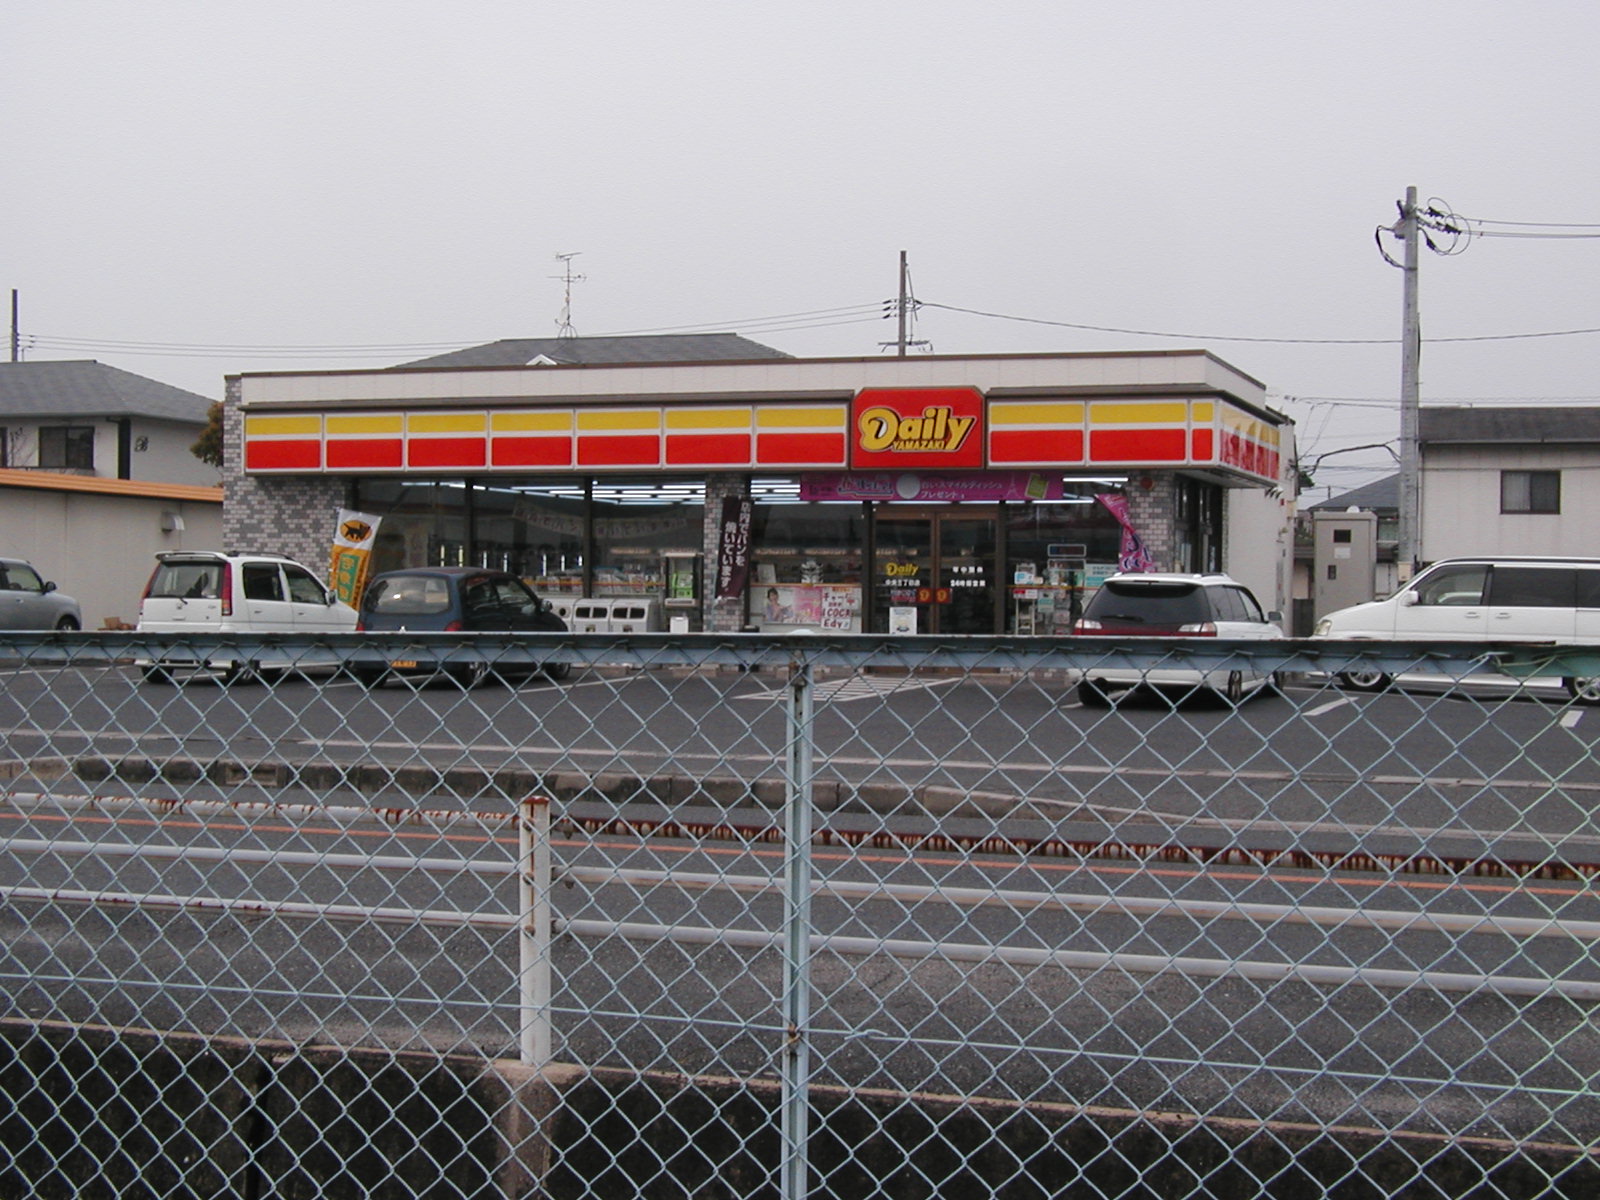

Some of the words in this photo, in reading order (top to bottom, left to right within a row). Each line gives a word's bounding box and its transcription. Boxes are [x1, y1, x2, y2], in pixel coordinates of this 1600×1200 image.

[859, 406, 975, 452] Daily
[893, 440, 945, 450] YAMAZAKI
[886, 561, 919, 577] Daily
